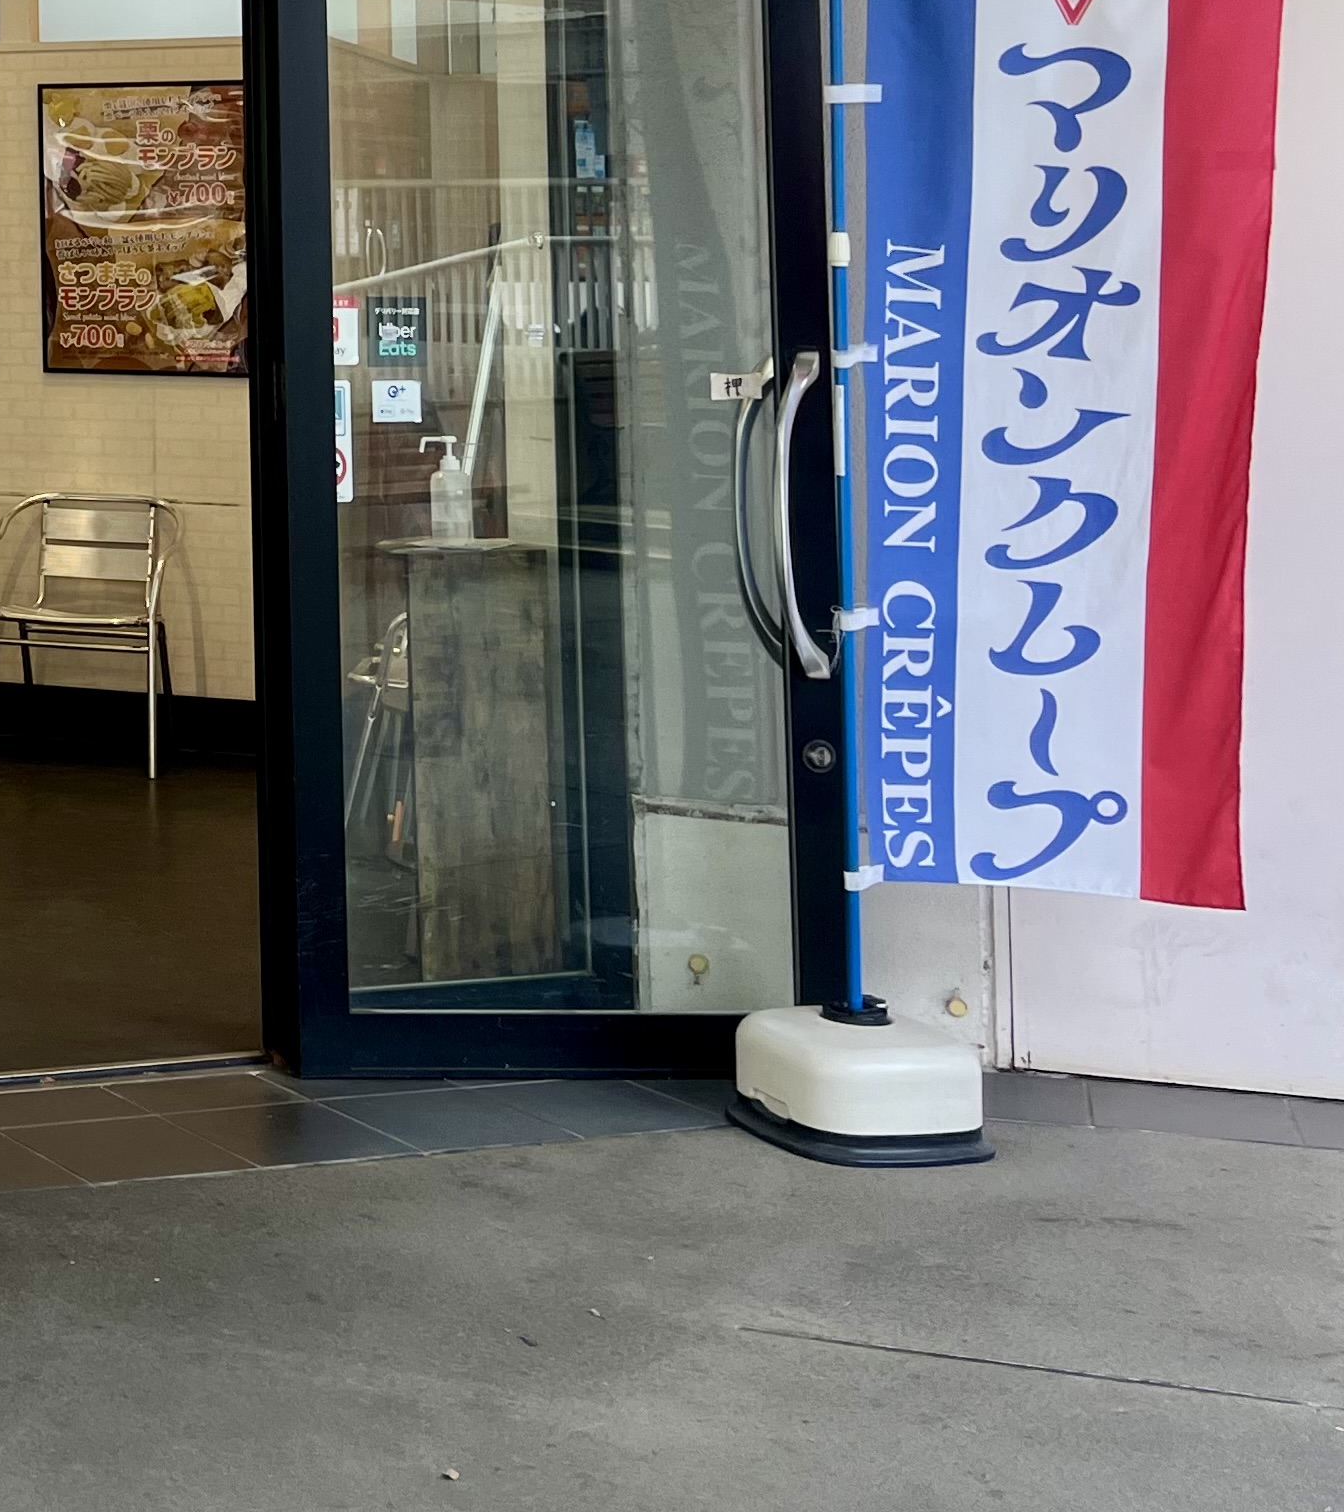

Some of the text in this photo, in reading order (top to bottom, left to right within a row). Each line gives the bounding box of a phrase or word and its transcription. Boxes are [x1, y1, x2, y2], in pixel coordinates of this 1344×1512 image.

[136, 119, 175, 144] 栗の
[138, 143, 237, 170] モンブラン
[169, 182, 227, 206] ¥700
[58, 261, 151, 285] さつま芋の
[58, 284, 158, 311] モンブラン
[60, 324, 117, 348] ¥700
[378, 339, 417, 356] Eats
[969, 42, 1141, 881] マリオンクレープ
[880, 242, 952, 869] MARION CRÊPES
